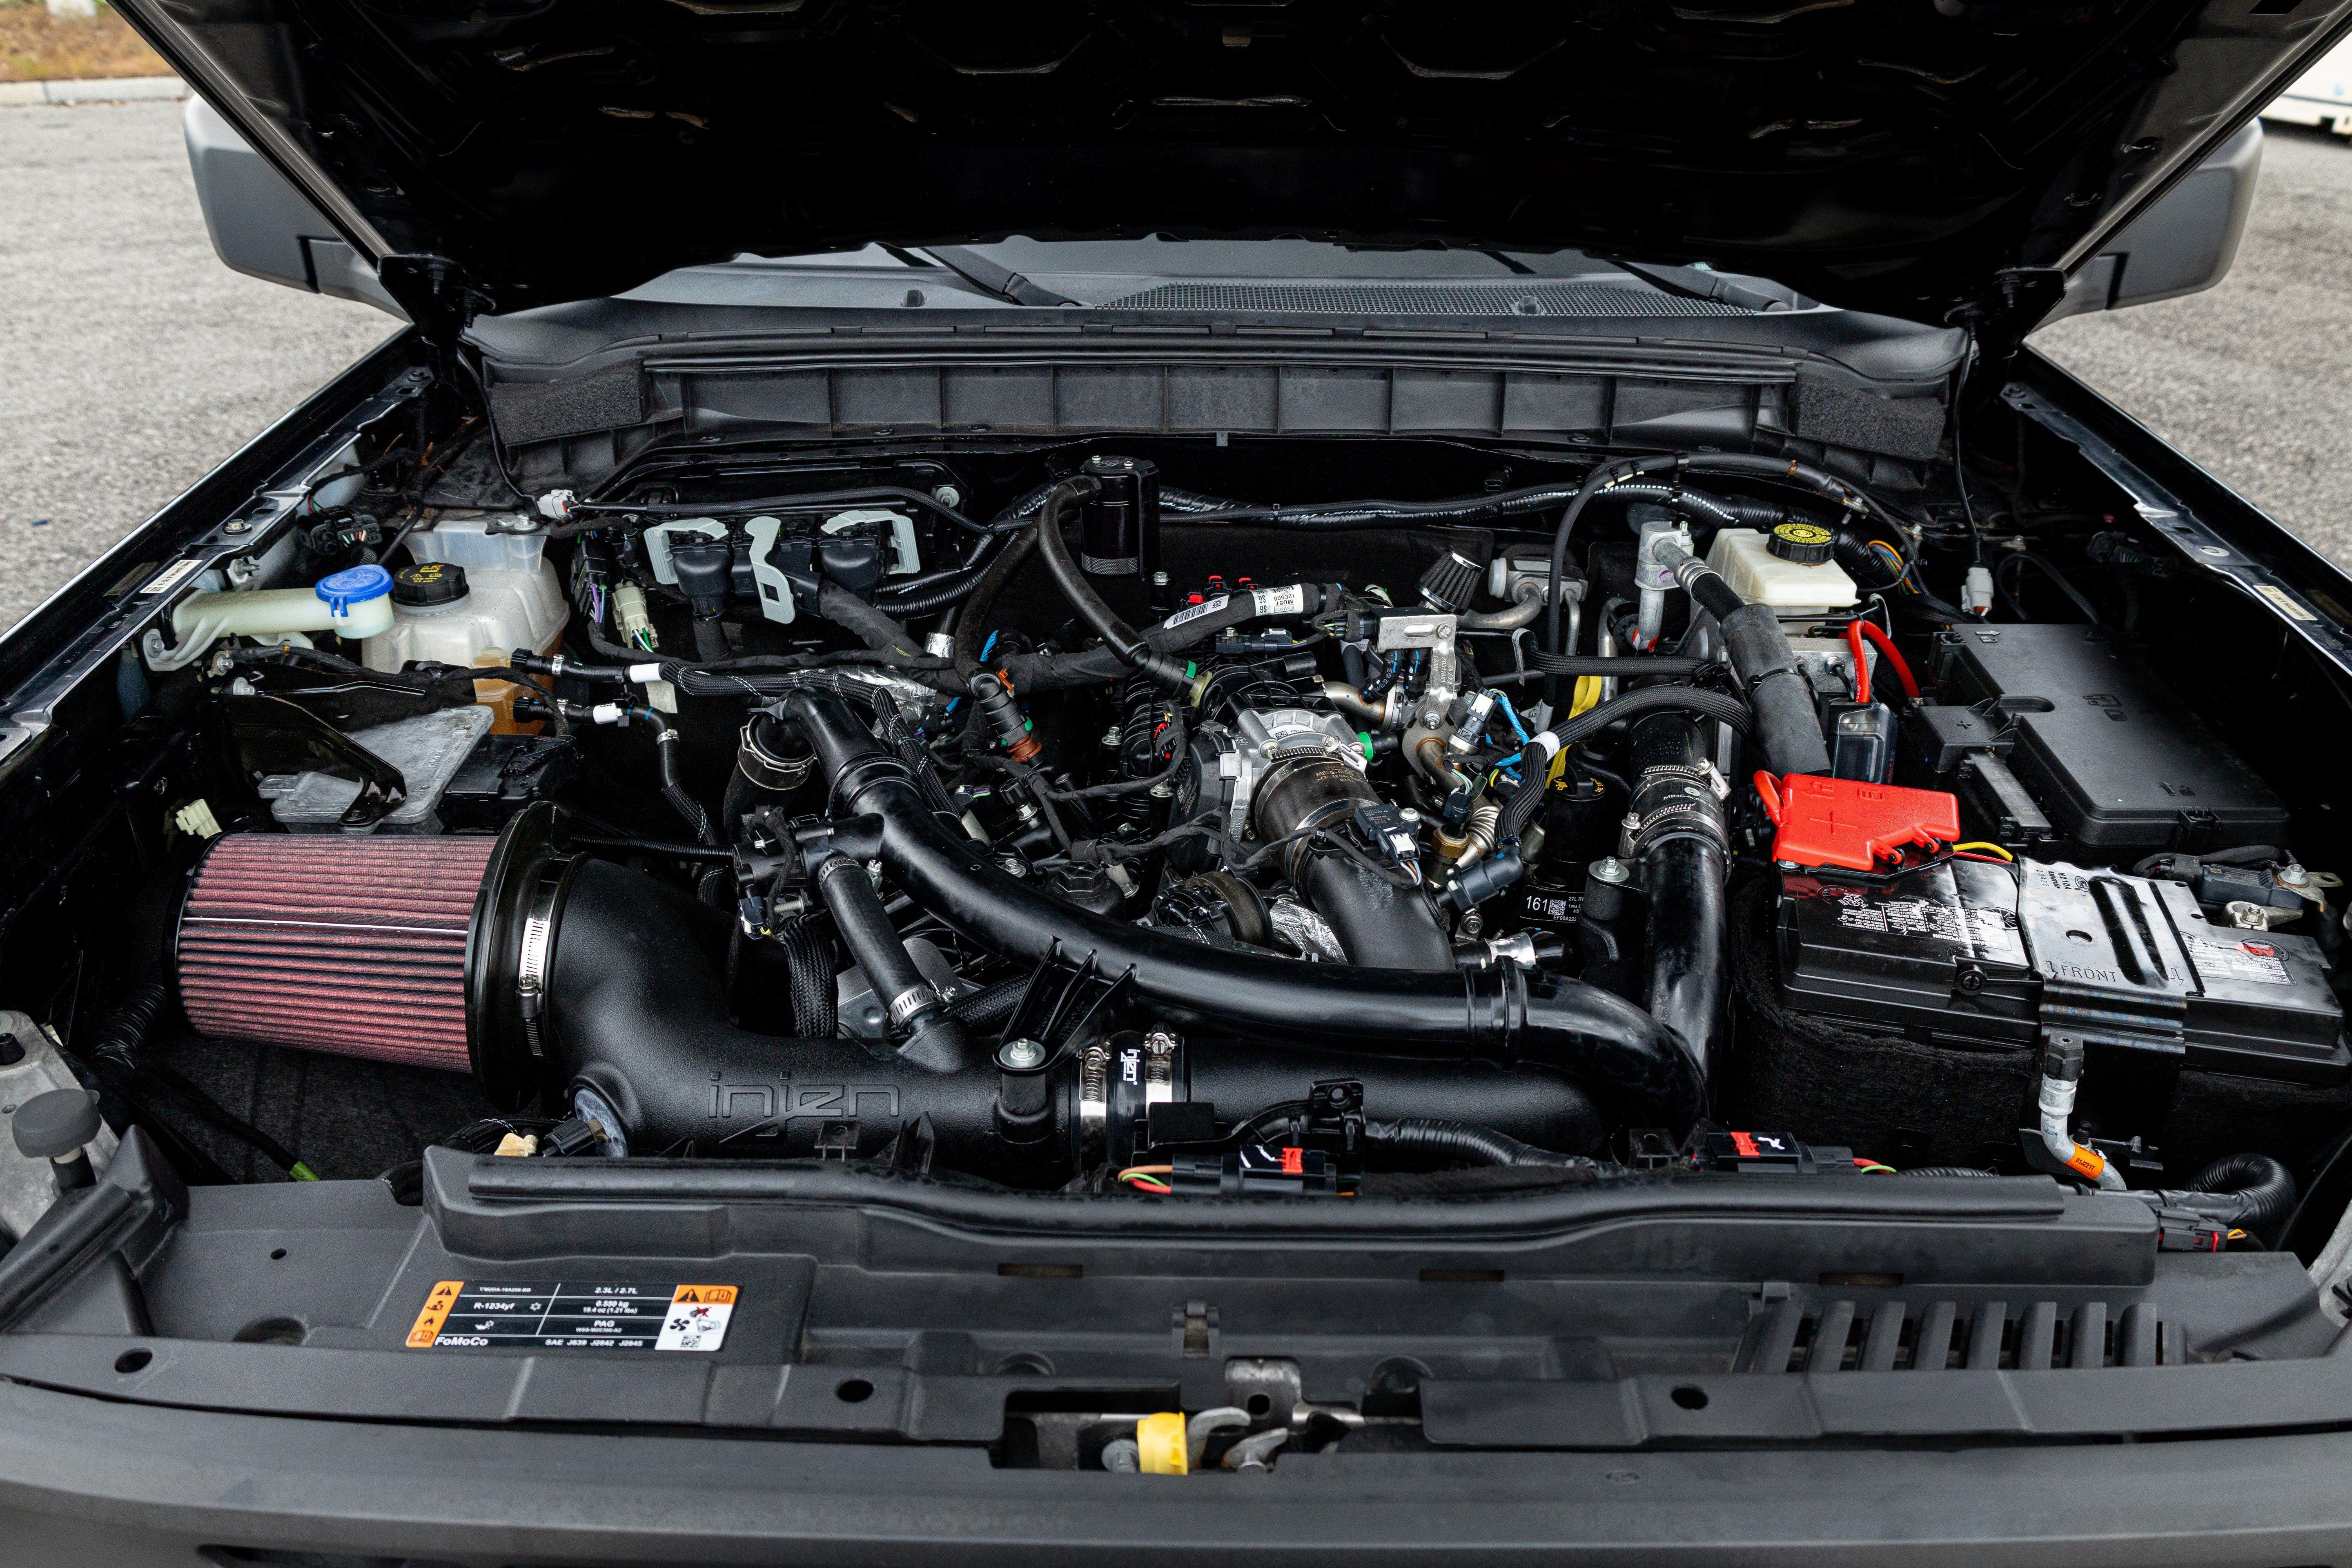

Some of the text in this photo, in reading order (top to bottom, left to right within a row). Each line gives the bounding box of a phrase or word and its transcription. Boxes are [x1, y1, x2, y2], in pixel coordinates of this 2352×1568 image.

[1259, 595, 1266, 603] SG
[1526, 895, 1548, 911] 161
[2061, 965, 2116, 982] FRONT
[2251, 973, 2287, 982] FoMoCo
[708, 1071, 900, 1143] injen
[2075, 1157, 2095, 1171] 01J221T
[473, 1302, 515, 1311] R-1234yf
[434, 1336, 488, 1346] FoMoCo
